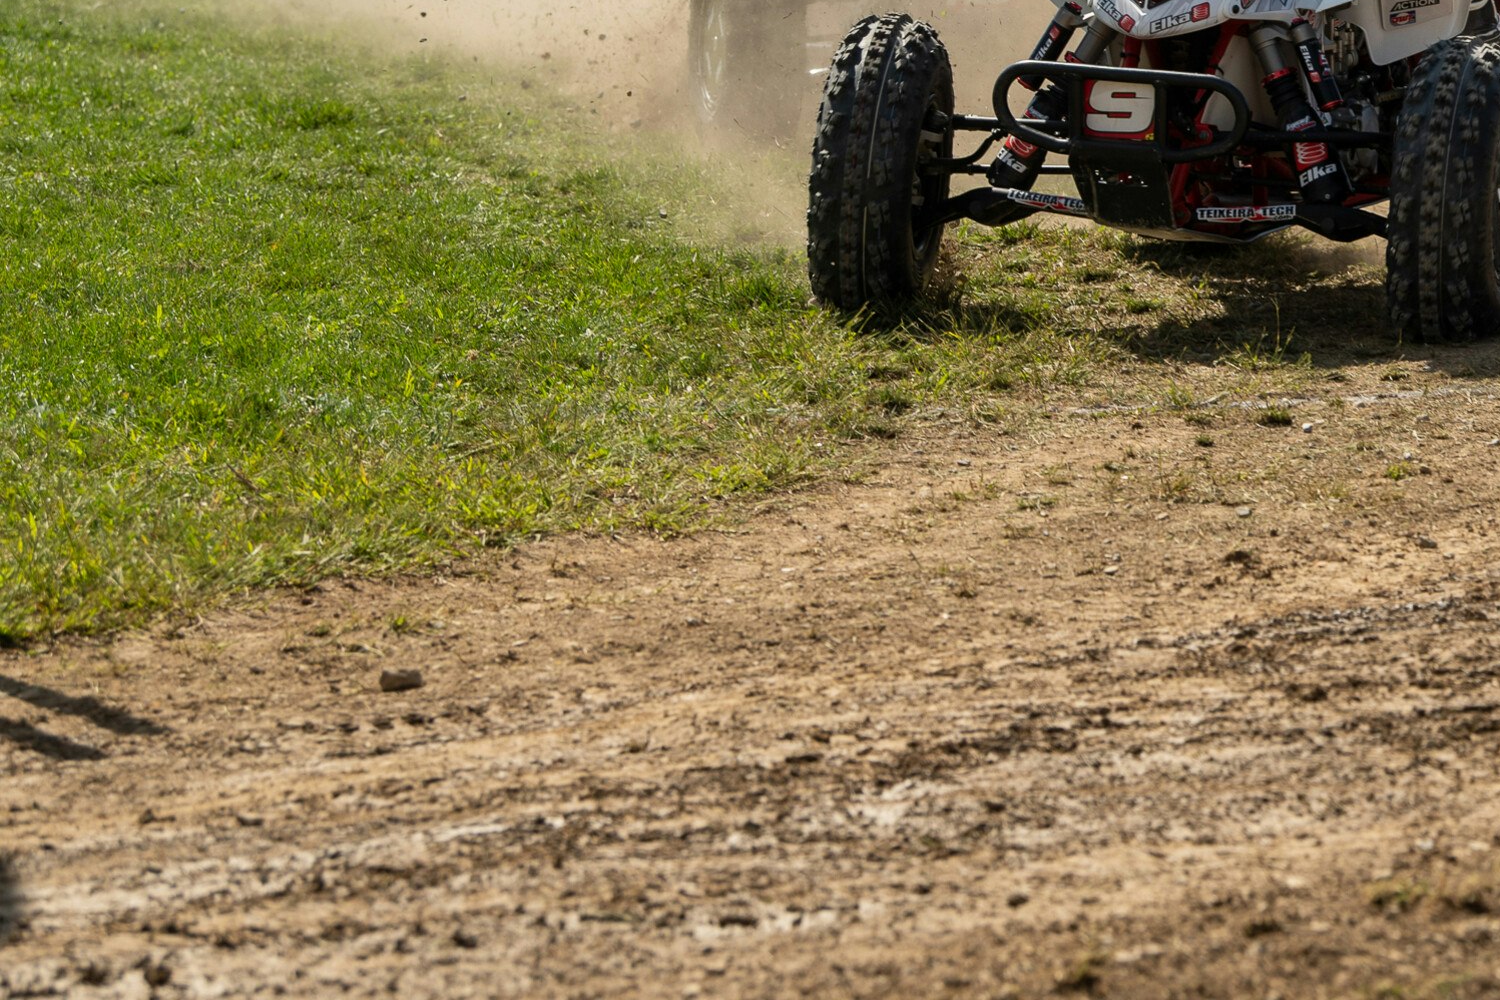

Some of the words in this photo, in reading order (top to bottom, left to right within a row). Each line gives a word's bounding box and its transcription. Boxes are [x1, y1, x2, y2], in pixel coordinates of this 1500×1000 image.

[1149, 12, 1192, 34] Elka
[1300, 45, 1315, 71] Elka
[1299, 163, 1337, 188] Elka
[1200, 208, 1254, 218] TEIXEIRA
[1262, 206, 1294, 217] TECH
